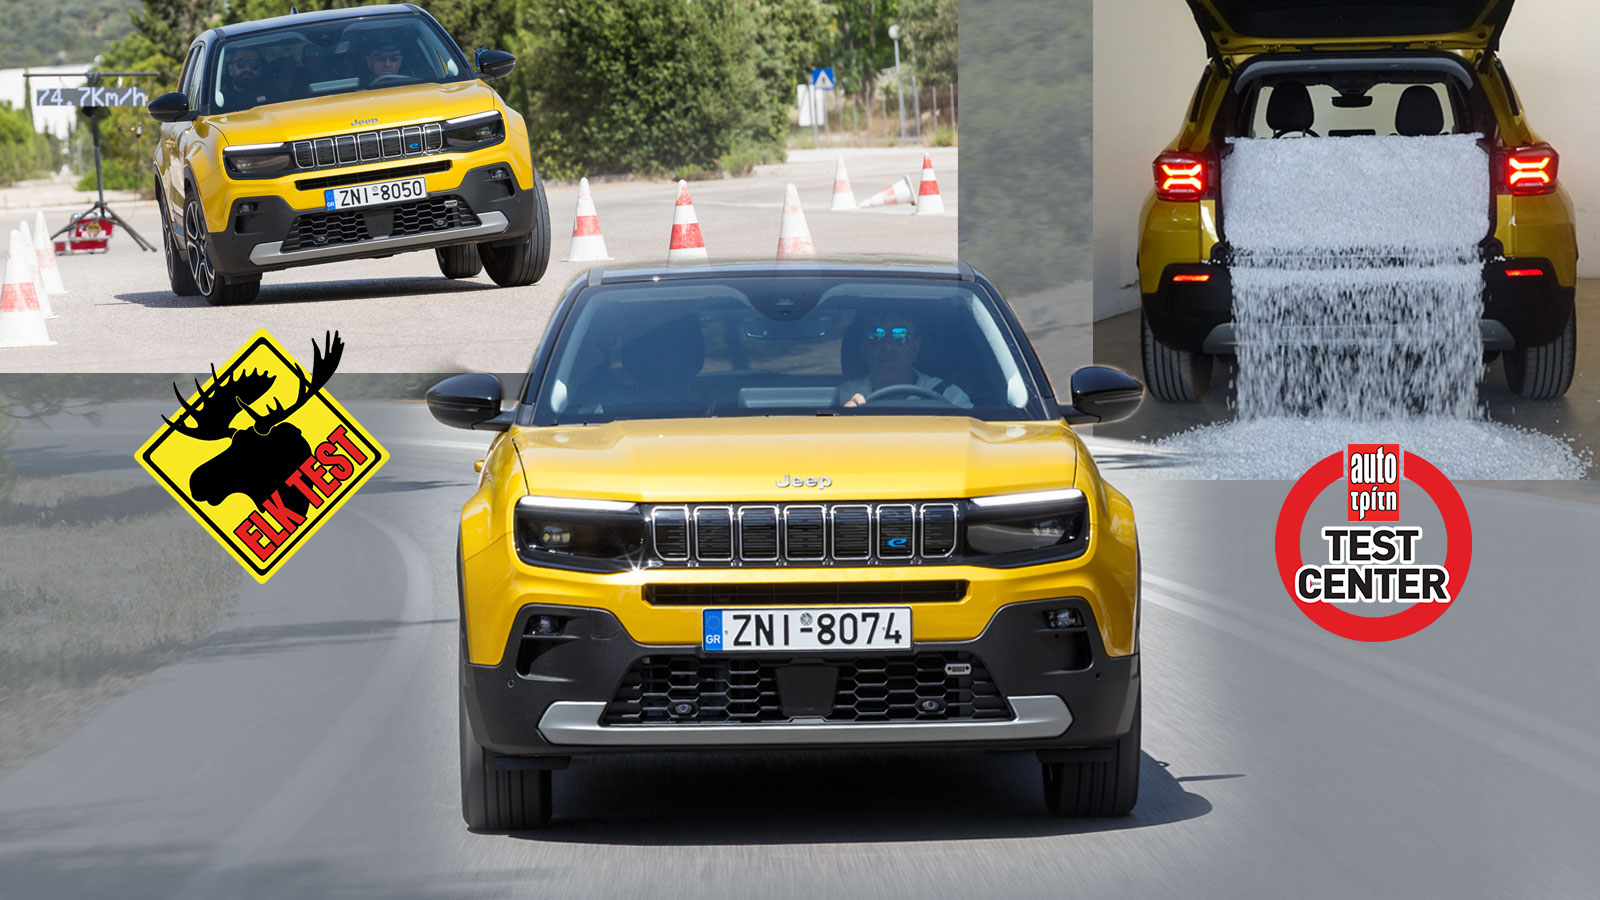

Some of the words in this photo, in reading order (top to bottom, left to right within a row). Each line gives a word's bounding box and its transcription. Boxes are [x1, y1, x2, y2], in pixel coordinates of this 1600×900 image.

[38, 86, 146, 107] 74.7Km/h
[350, 117, 379, 126] Jeep
[339, 180, 422, 207] ZNI-8050
[776, 474, 832, 489] Jeep
[705, 634, 721, 645] GR
[732, 612, 902, 646] ZNI-8074
